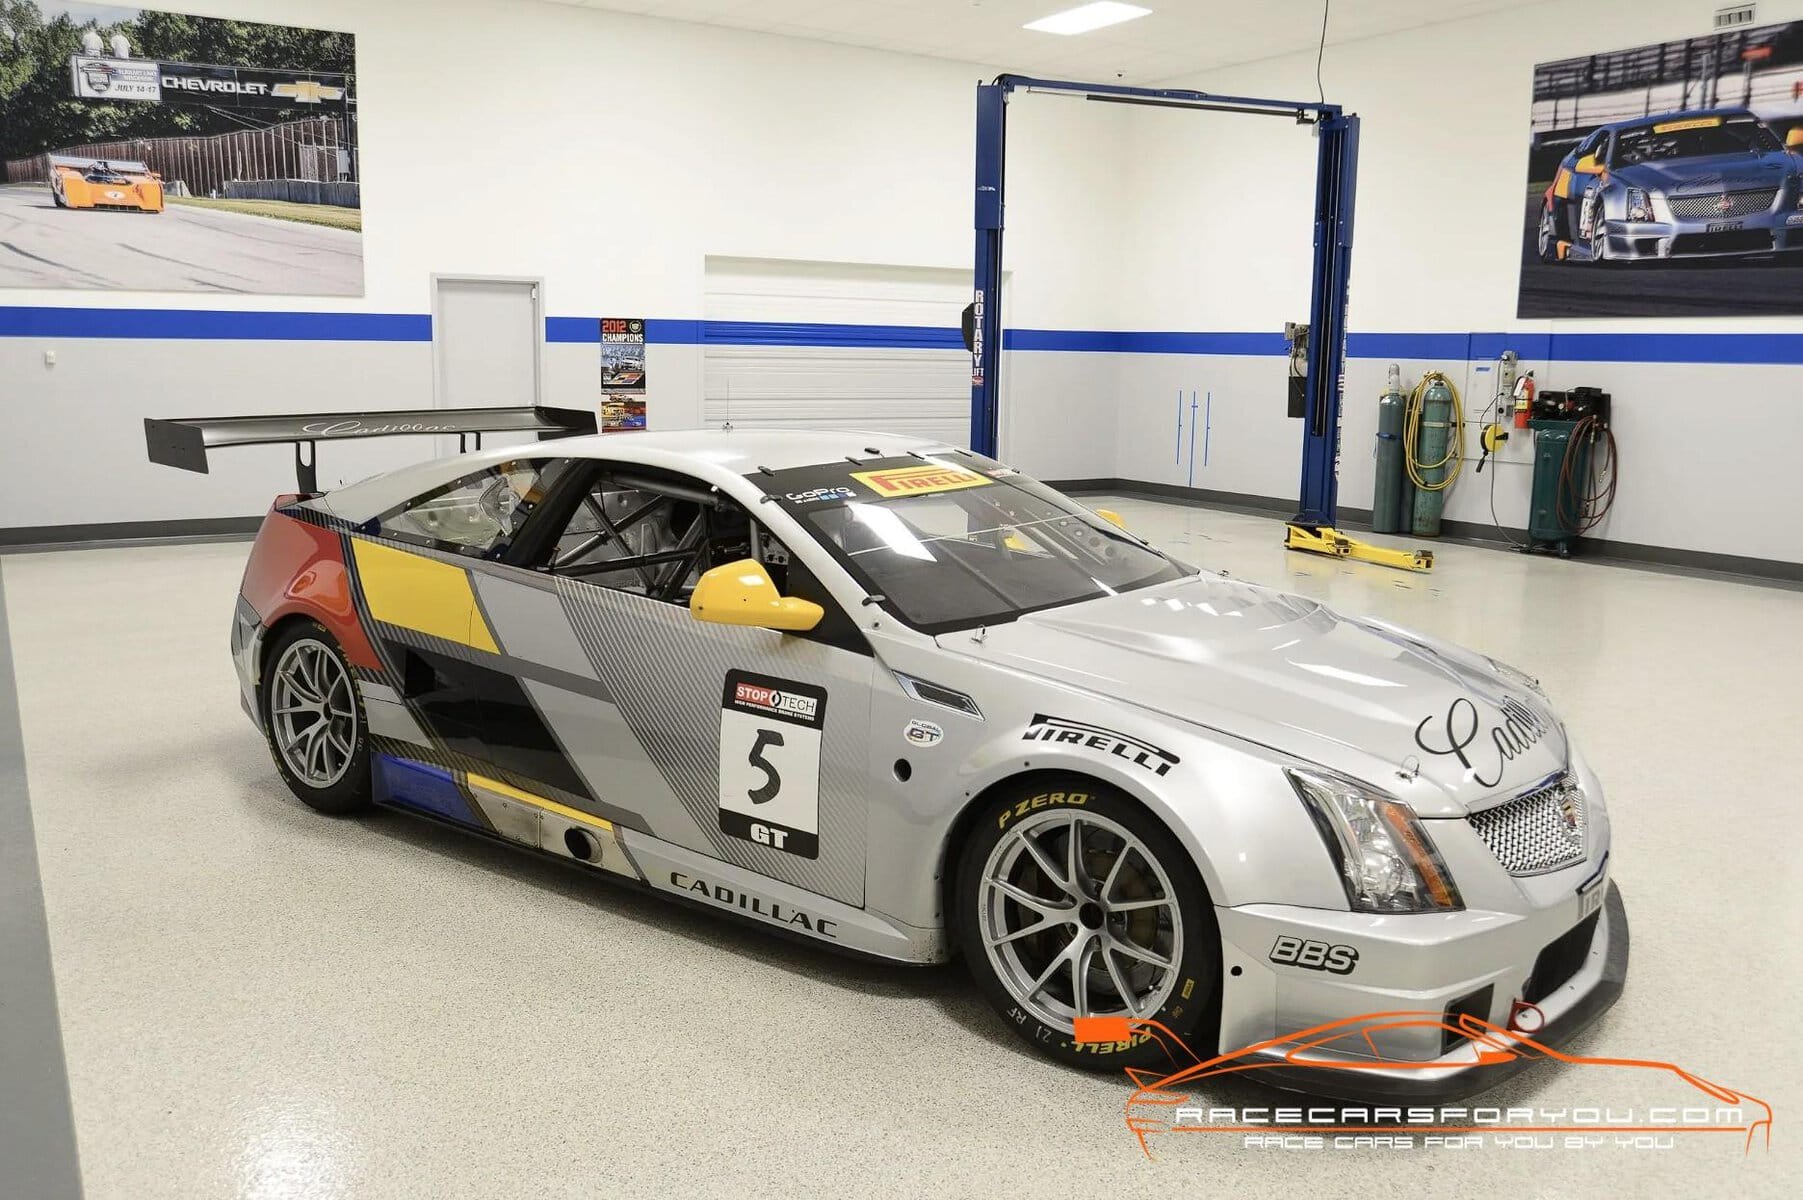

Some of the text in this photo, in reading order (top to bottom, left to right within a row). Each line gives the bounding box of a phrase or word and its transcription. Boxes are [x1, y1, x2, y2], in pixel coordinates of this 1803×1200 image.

[115, 85, 133, 93] JULY
[161, 76, 268, 96] CHEVROLET
[602, 320, 626, 333] 2012
[602, 333, 643, 342] CHAMPIONS
[973, 290, 984, 368] ROTARY
[302, 420, 457, 436] Cadillac
[868, 467, 978, 491] PIRELLI
[785, 486, 850, 501] GoPro
[910, 727, 940, 742] GT
[1022, 712, 1181, 777] PIRELLI
[747, 728, 785, 805] 5
[998, 792, 1089, 829] P ZERO
[750, 822, 789, 849] GT
[670, 871, 838, 938] CADILLAC
[1268, 935, 1360, 975] BBS
